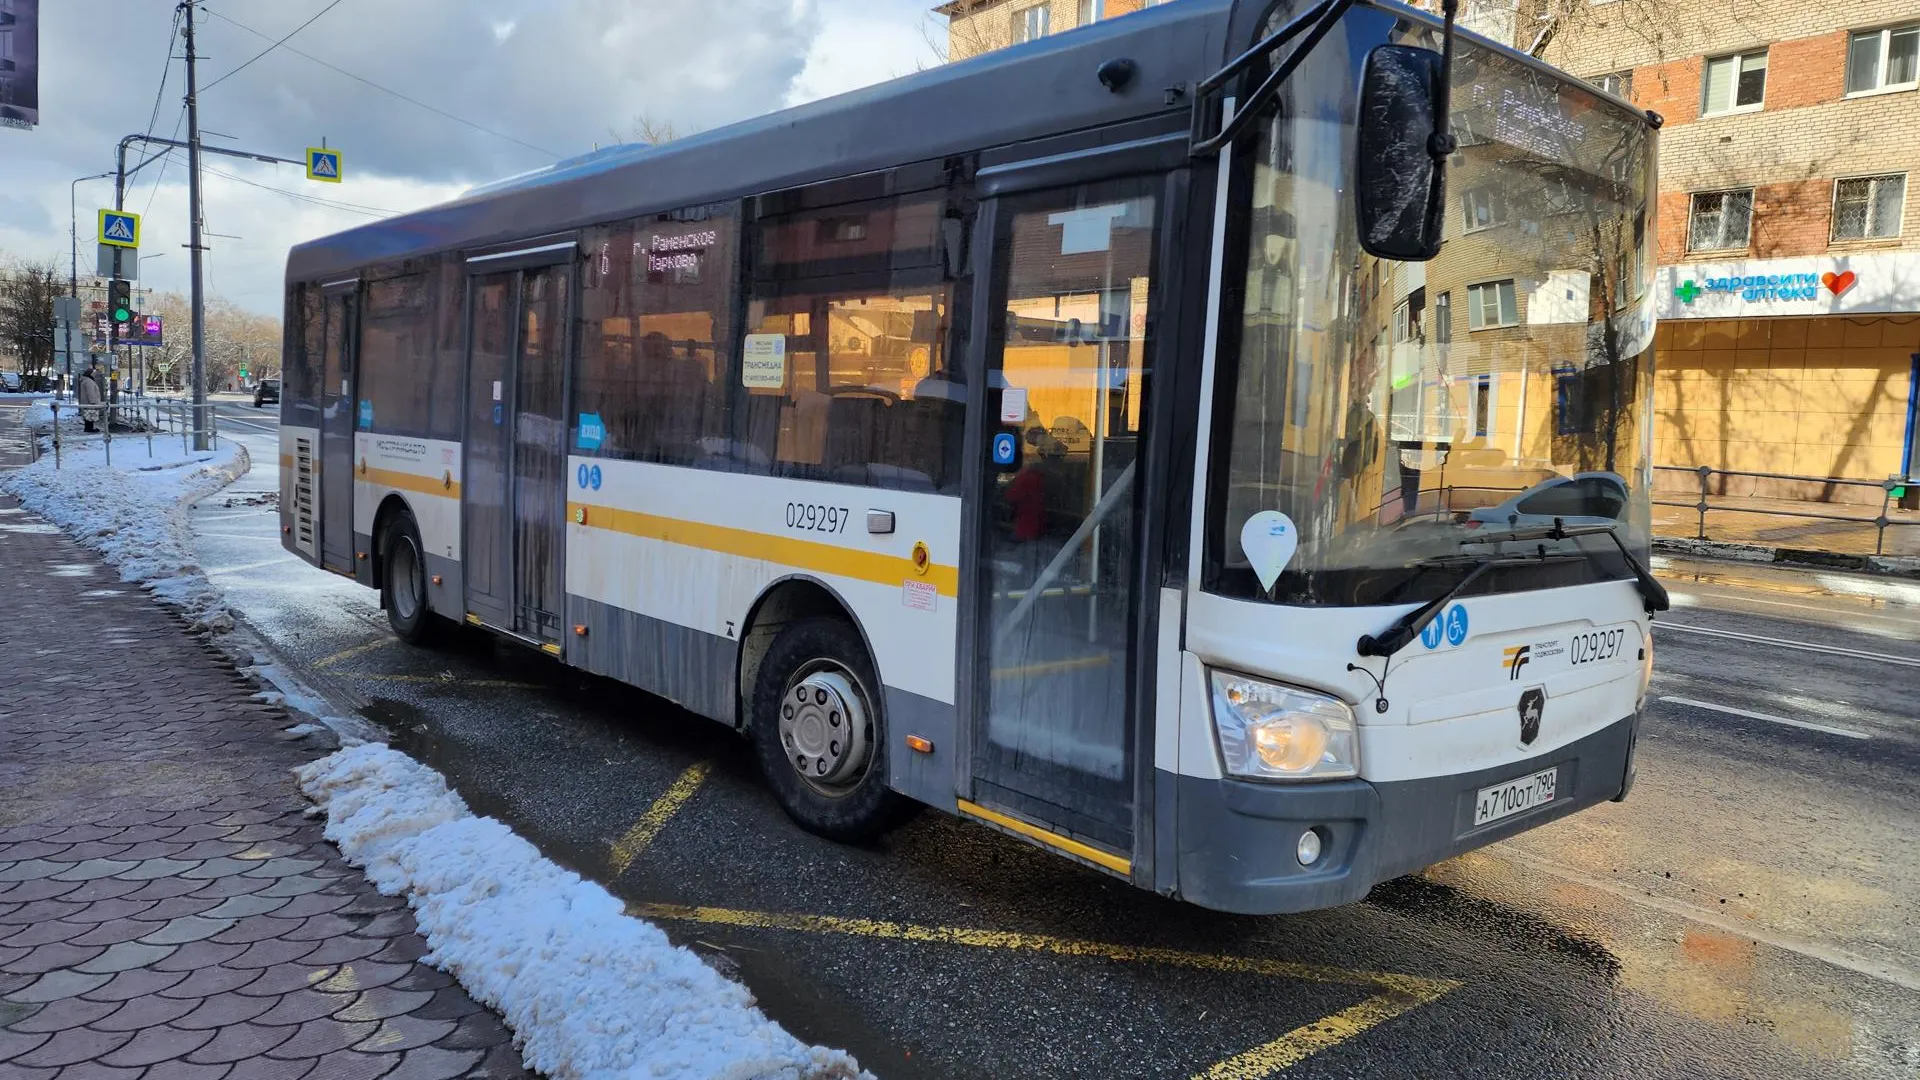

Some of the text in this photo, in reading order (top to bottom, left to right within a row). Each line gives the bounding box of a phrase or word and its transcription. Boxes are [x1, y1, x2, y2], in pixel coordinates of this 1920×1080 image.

[652, 231, 716, 252] Раменское
[601, 243, 609, 275] 6
[648, 253, 698, 272] Марково
[1704, 272, 1817, 291] здравсити
[1742, 284, 1816, 302] аптека
[786, 502, 849, 534] 029297
[1571, 628, 1625, 665] 029297
